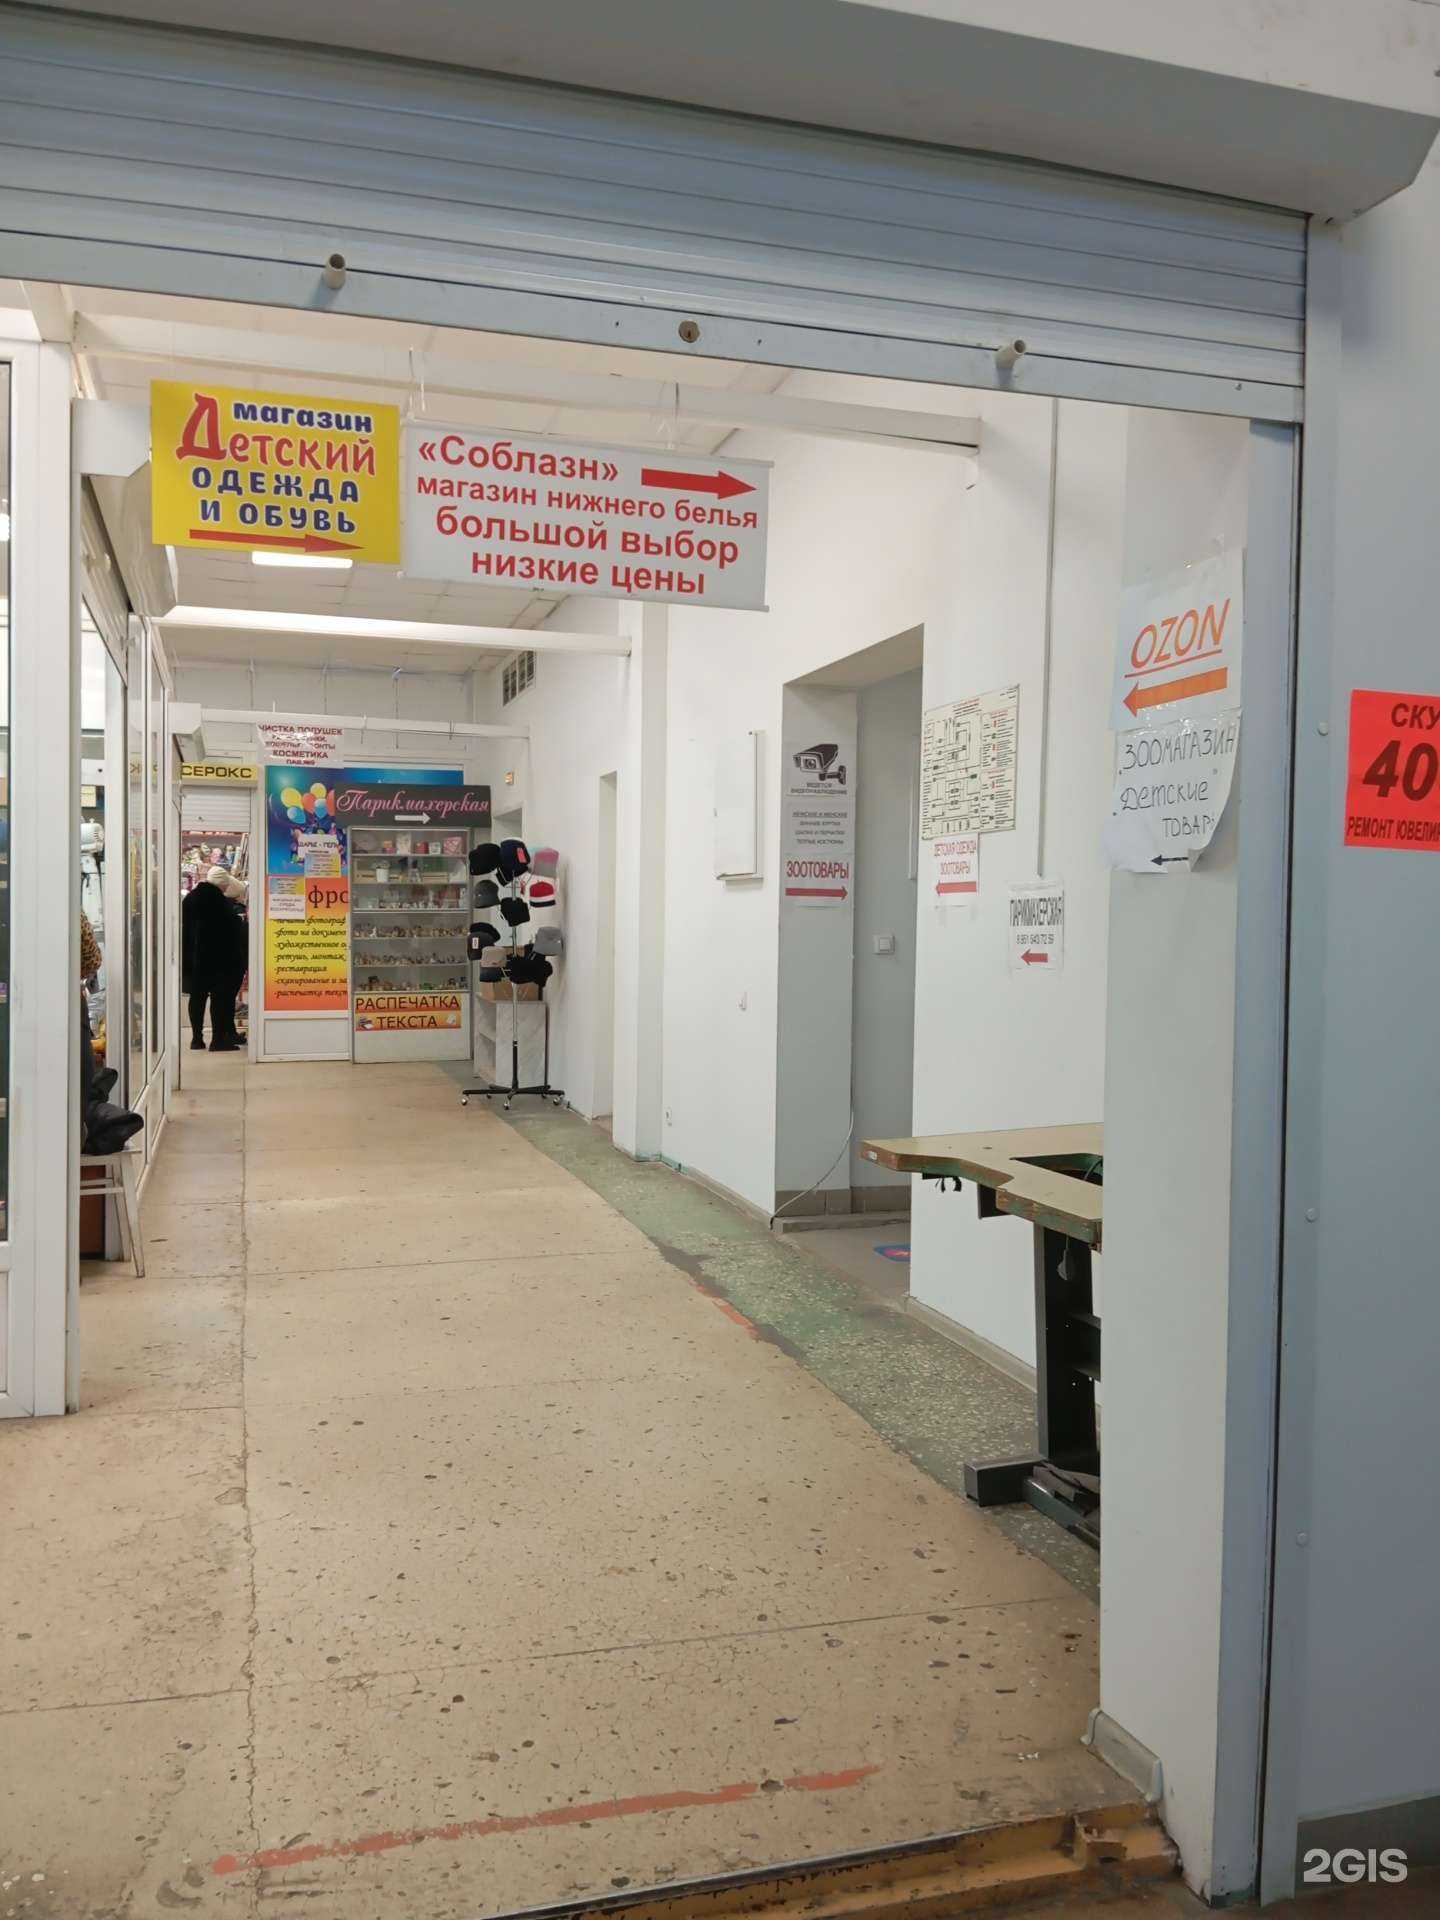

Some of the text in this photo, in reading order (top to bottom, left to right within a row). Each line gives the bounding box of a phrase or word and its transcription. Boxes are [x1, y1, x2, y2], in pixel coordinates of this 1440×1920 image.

[176, 393, 376, 476] Детский
[233, 403, 372, 433] магазин
[418, 435, 618, 481] «Соблазн»
[192, 467, 359, 504] ОДЕЖДА
[417, 476, 758, 529] магазин нижнего белья
[200, 499, 356, 534] И ОБУВЬ
[436, 506, 739, 570] большой выбор
[472, 552, 705, 594] низкие цены
[1129, 598, 1231, 669] OZON
[258, 725, 295, 733] ЧИСТКА
[272, 750, 329, 759] КОСМЕТИКА
[1122, 726, 1236, 770] ЗООМАГАЗИН
[336, 789, 490, 818] Парикмахерская
[1346, 816, 1394, 839] РЕМОНТ
[786, 860, 850, 879] ЗООТОВАРЫ
[355, 994, 460, 1011] РАСПЕЧАТКА
[376, 1014, 439, 1030] ТЕКСТА
